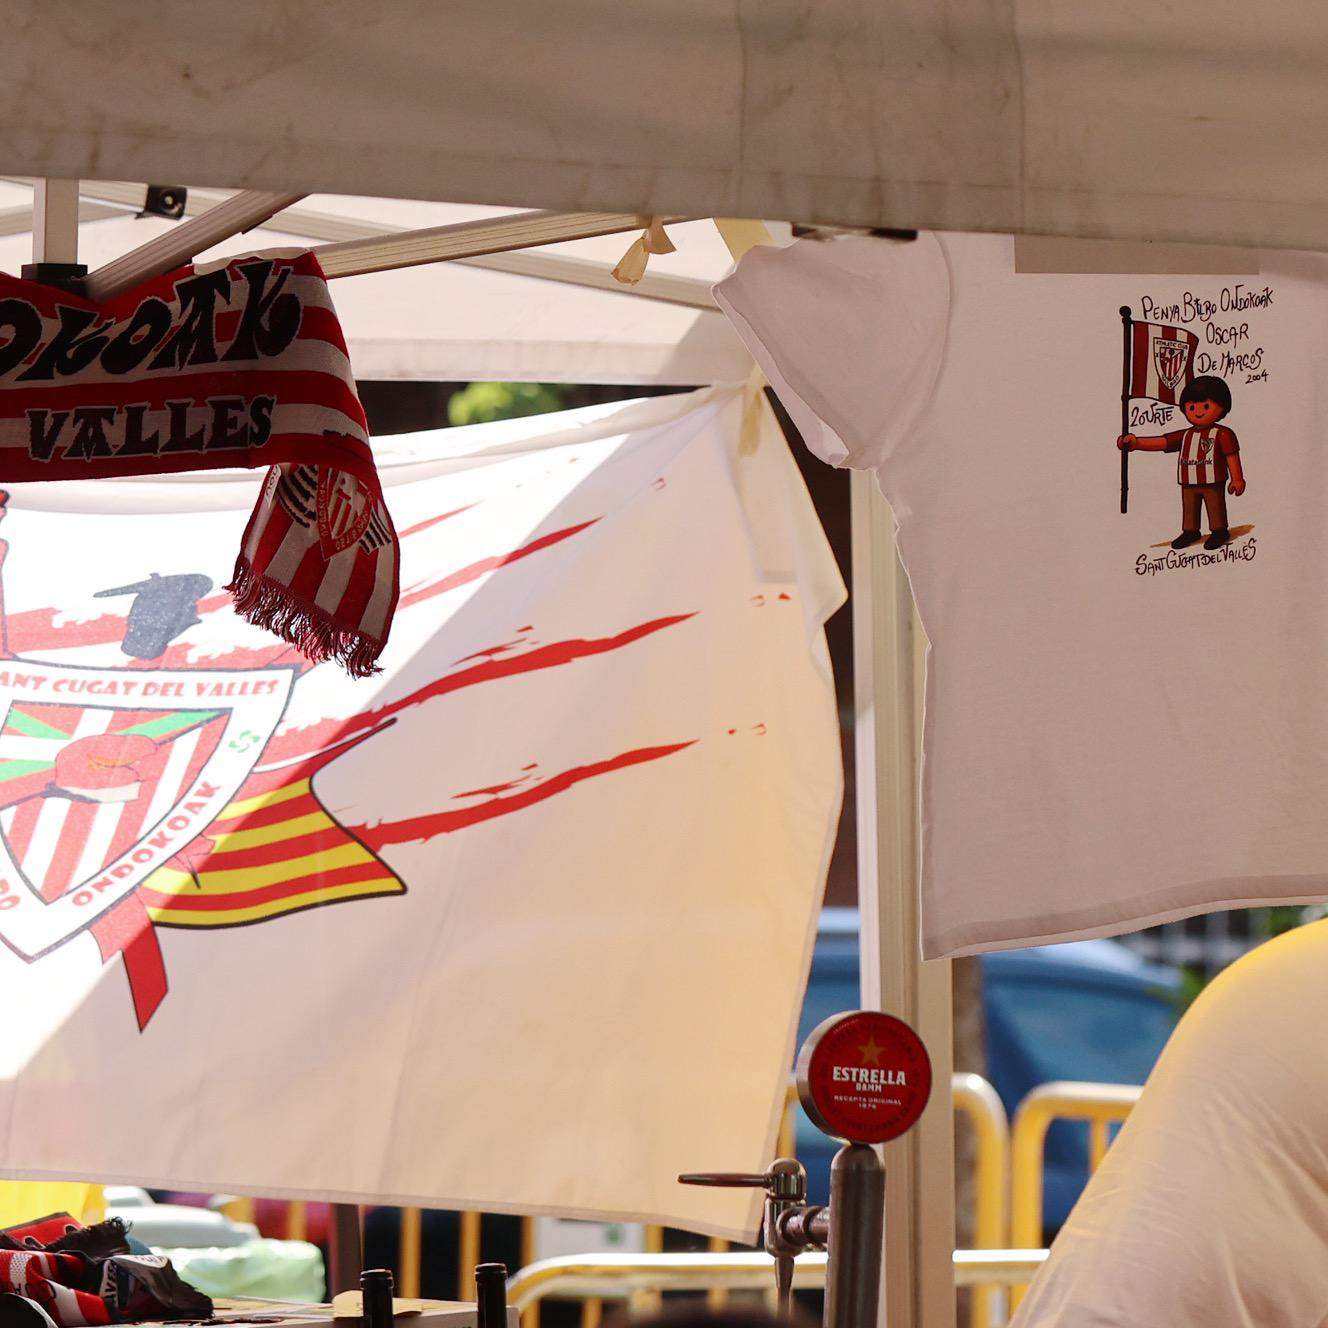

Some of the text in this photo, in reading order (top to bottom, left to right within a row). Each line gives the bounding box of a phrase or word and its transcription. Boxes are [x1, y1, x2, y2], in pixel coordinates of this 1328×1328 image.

[1206, 322, 1249, 348] OSCAR
[1219, 348, 1264, 378] MARCOS
[1245, 369, 1269, 384] 2004
[25, 394, 277, 463] VALLES
[1134, 553, 1166, 576] SANT
[51, 676, 139, 696] CUGAT
[141, 680, 191, 698] DEL
[195, 679, 280, 698] VALLES
[70, 780, 222, 908] ONDOKOAK
[832, 1065, 907, 1086] ESTRELLA
